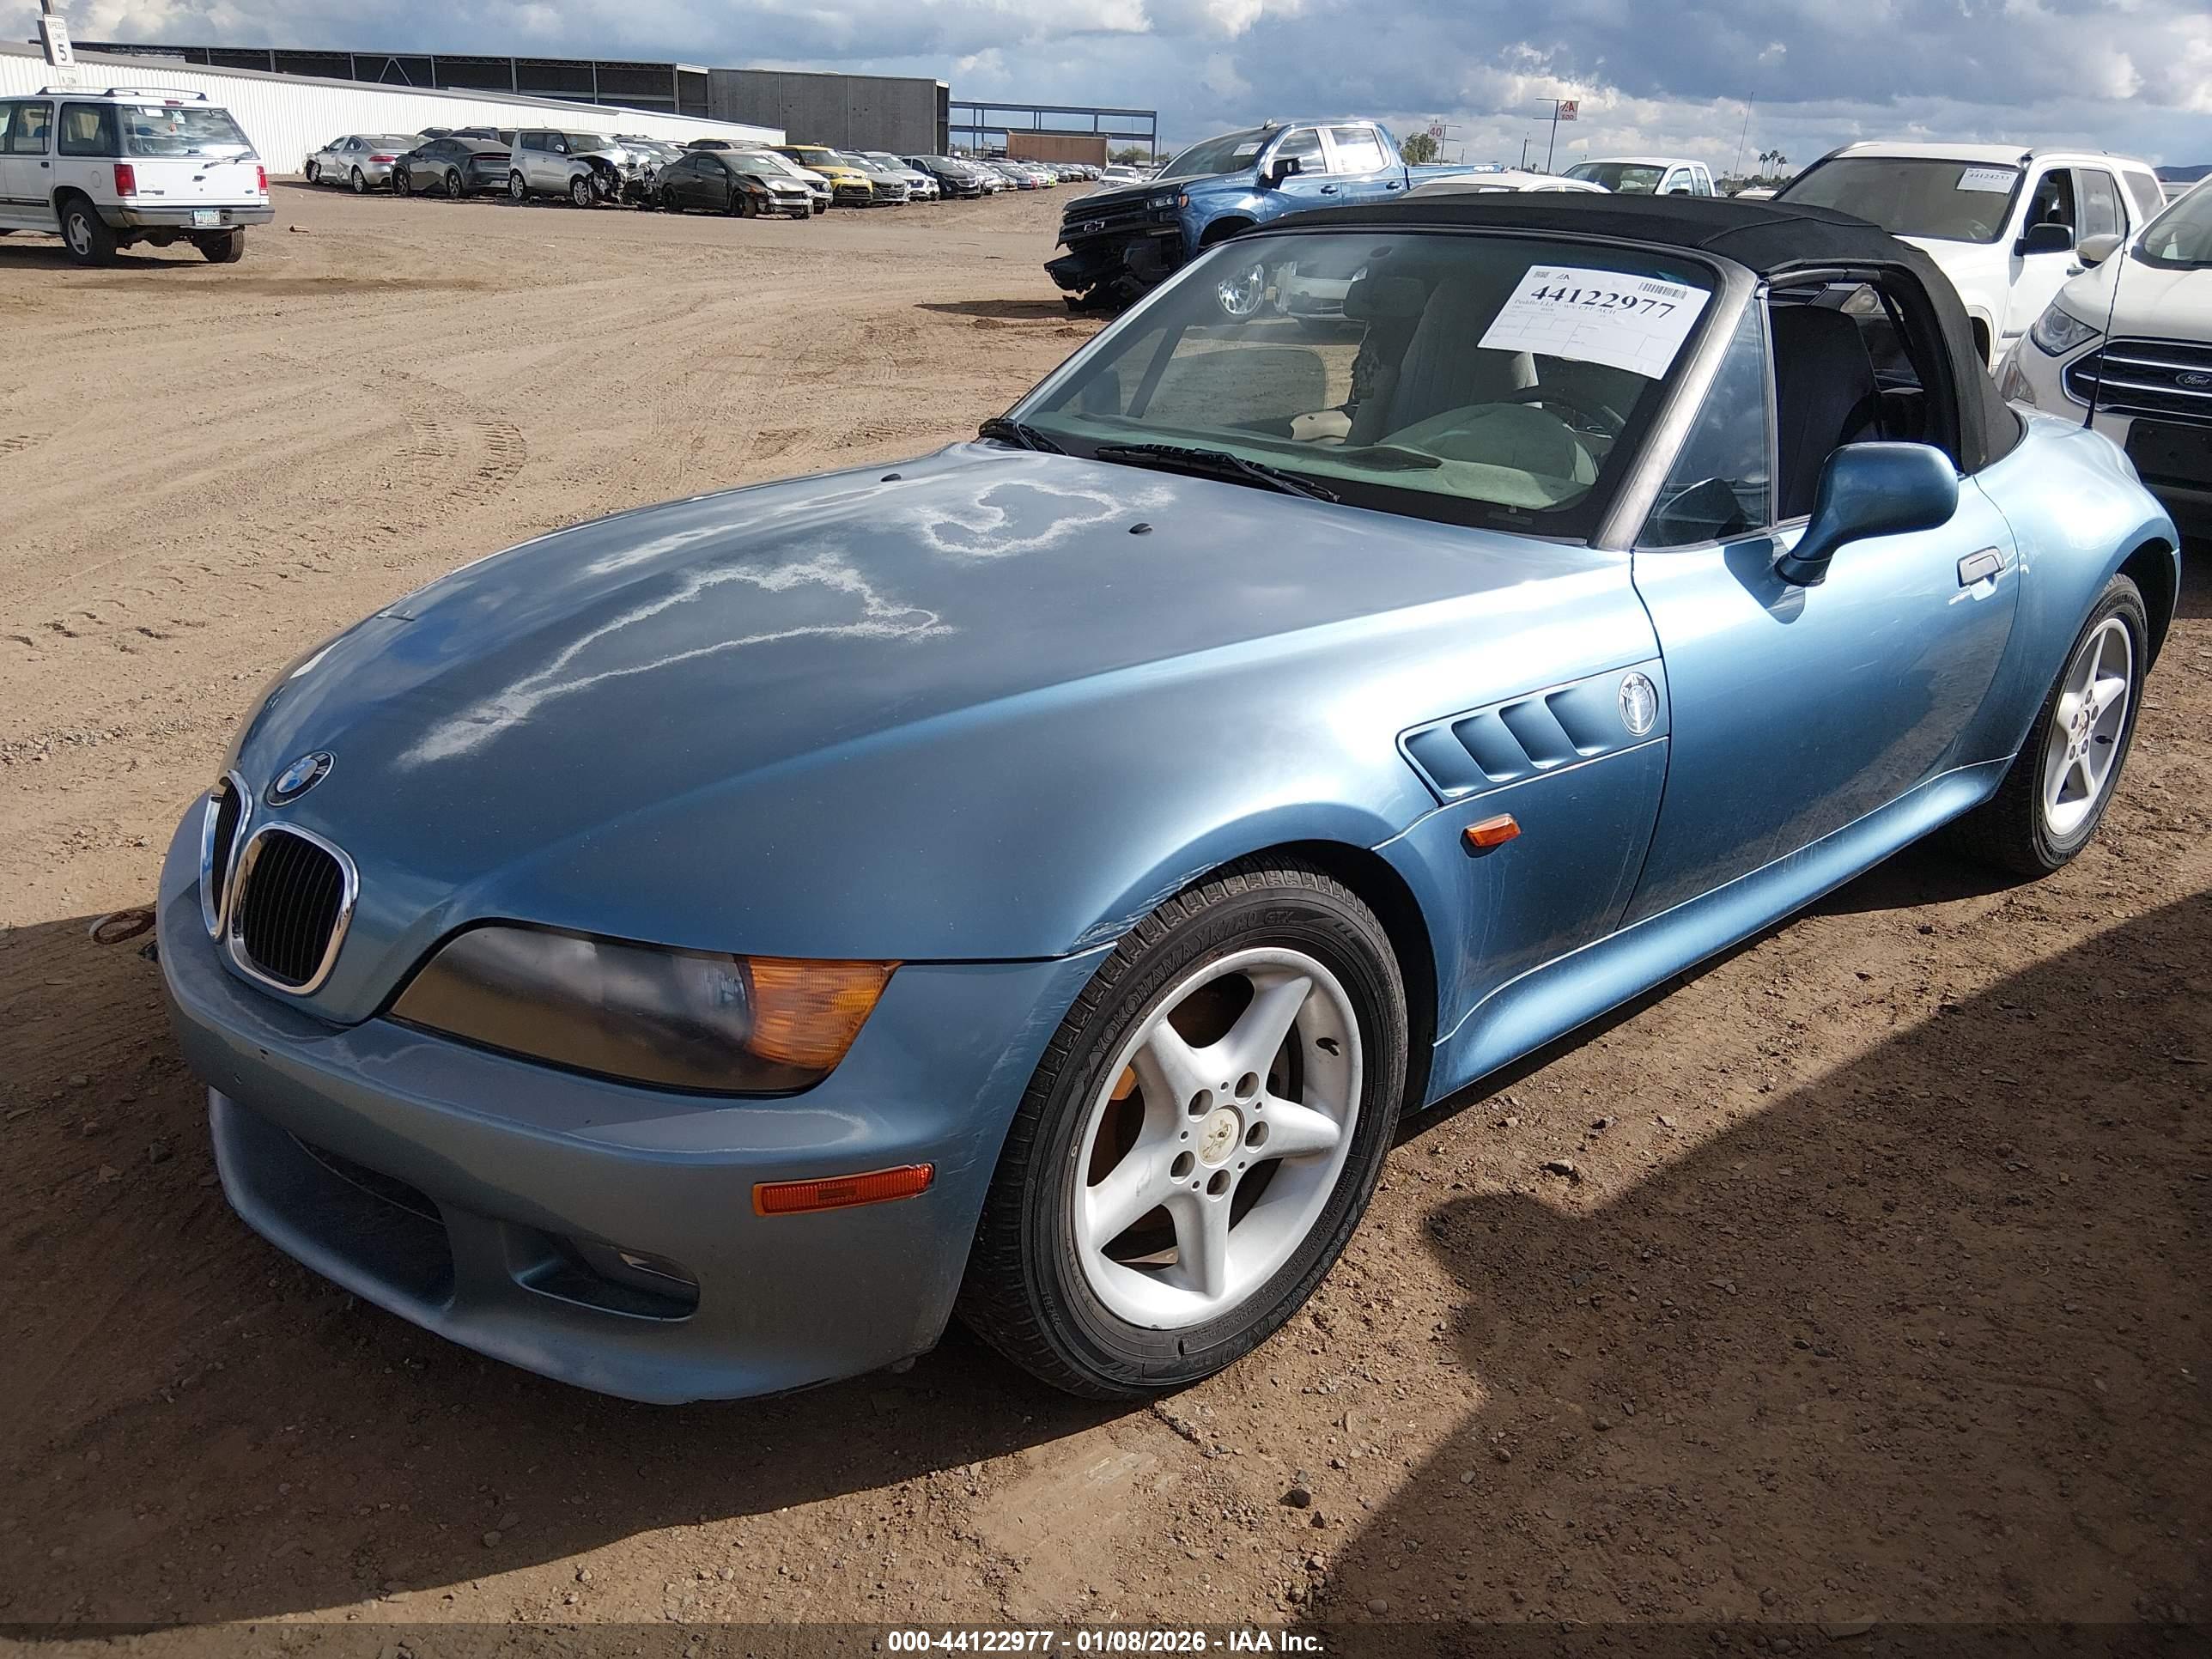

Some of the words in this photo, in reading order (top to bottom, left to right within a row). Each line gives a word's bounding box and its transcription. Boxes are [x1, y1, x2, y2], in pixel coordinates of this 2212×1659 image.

[58, 43, 68, 62] 5
[1429, 126, 1443, 137] 40
[1530, 285, 1677, 319] 44122977
[2185, 374, 2210, 386] Ford
[1620, 672, 1651, 698] BMW
[1092, 942, 1197, 1055] YOKOHAMA
